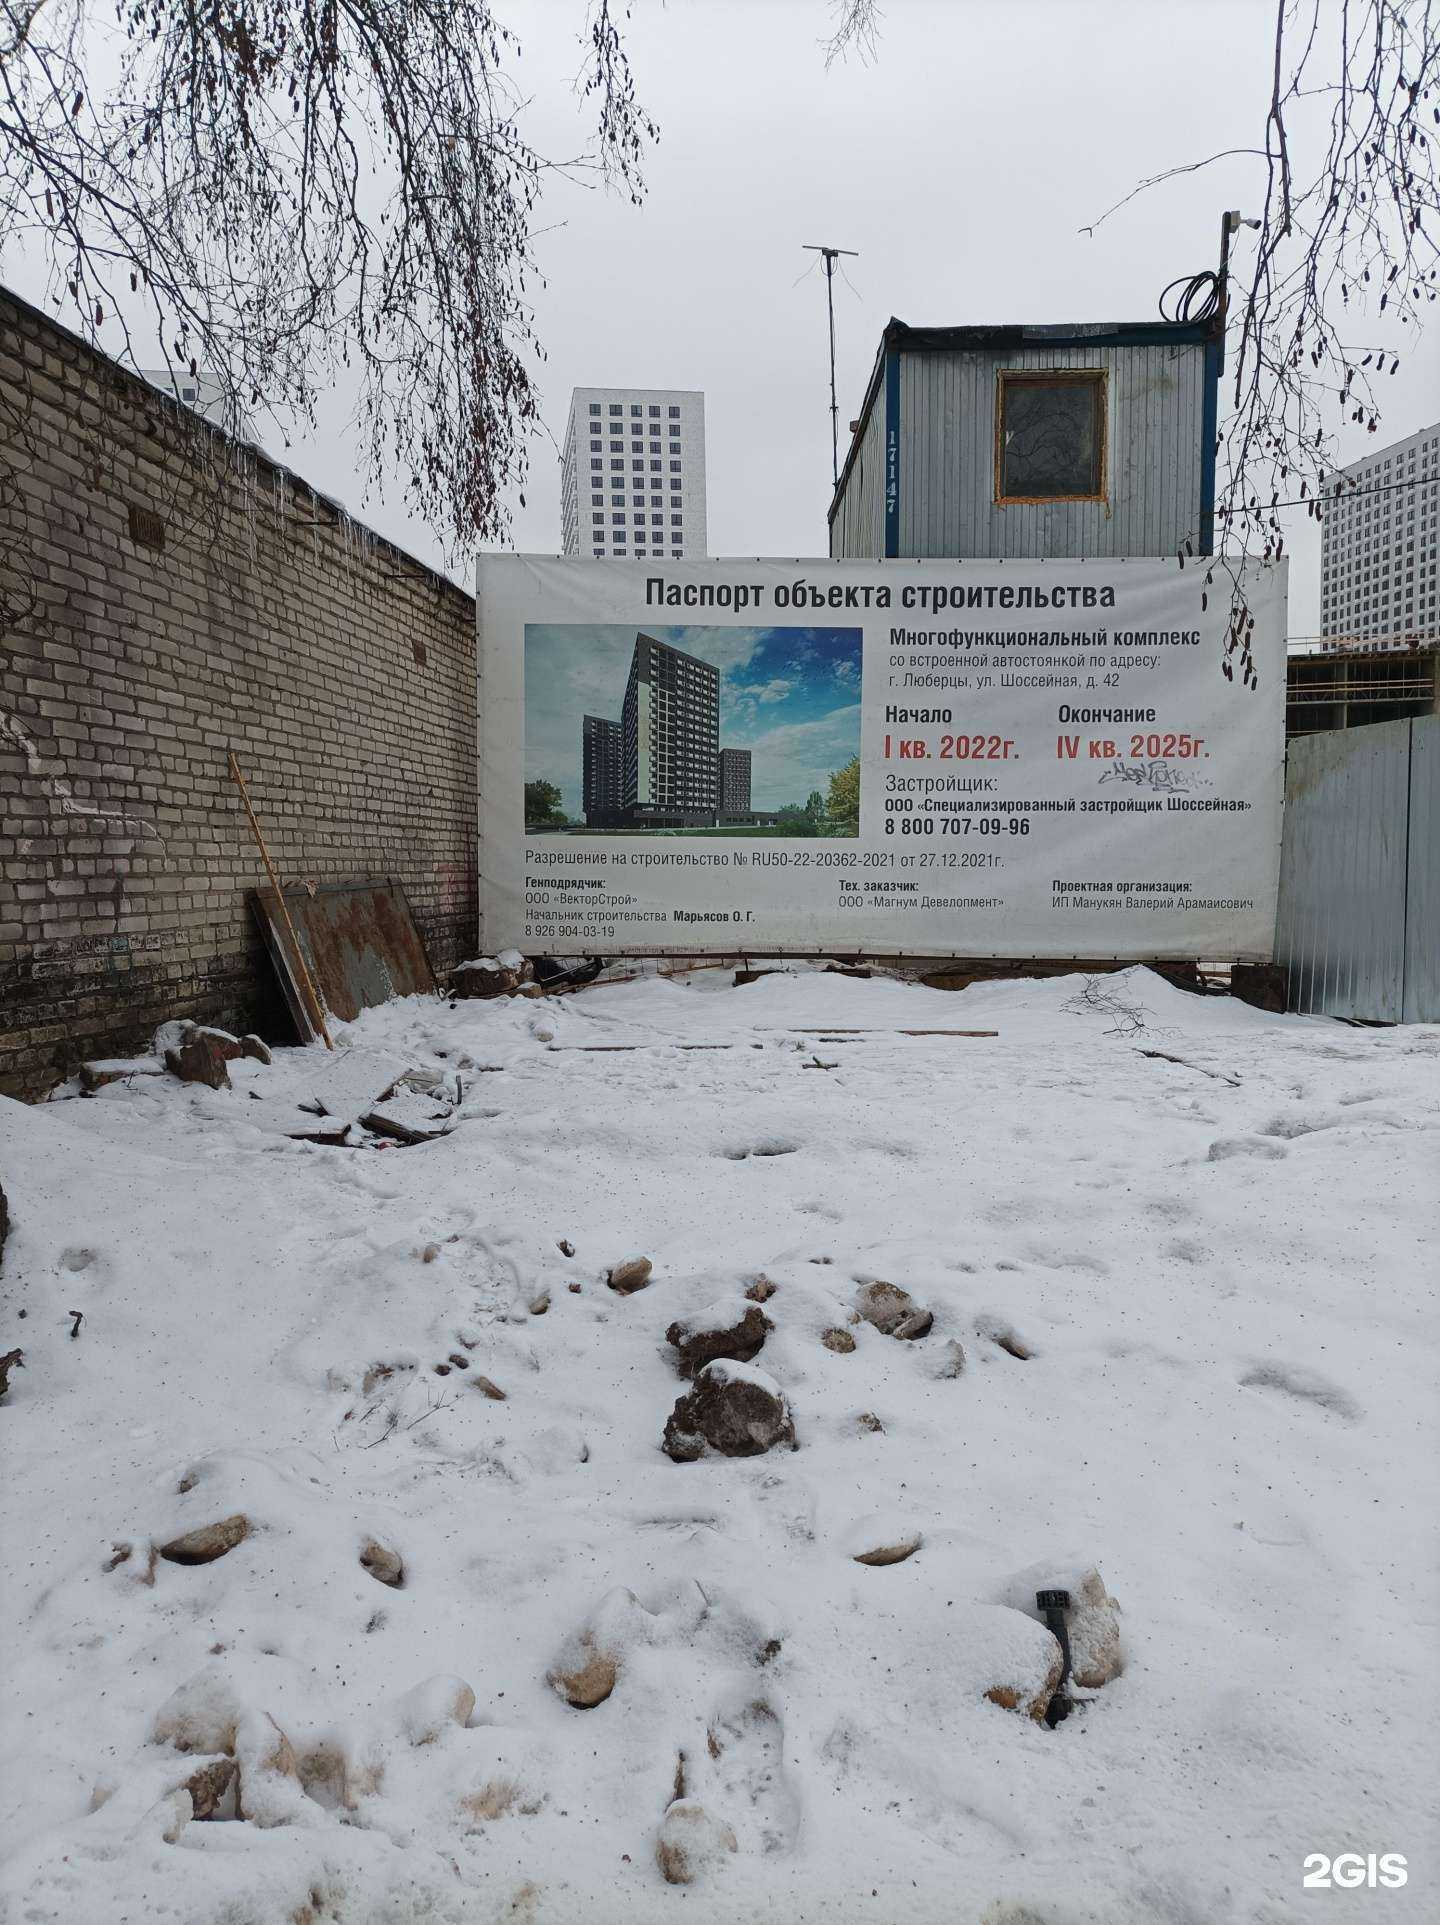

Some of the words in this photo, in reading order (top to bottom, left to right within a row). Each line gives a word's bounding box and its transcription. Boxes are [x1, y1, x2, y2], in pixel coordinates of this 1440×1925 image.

[887, 431, 898, 513] 17147
[647, 578, 764, 613] Паспорт
[775, 579, 891, 608] объекта
[902, 586, 1115, 614] строительства
[890, 628, 1107, 649] Многофункциональный
[1114, 631, 1200, 646] комплекс
[888, 656, 905, 668] со
[910, 653, 989, 669] встроенной
[992, 653, 1085, 669] автостоянкой
[1088, 657, 1106, 670] по
[1110, 656, 1160, 671] адресу:
[888, 674, 899, 688] г.
[903, 672, 973, 690] Люберцы,
[976, 676, 997, 690] ул.
[1001, 672, 1081, 688] Шоссейная,
[1086, 673, 1098, 689] д.
[1103, 673, 1119, 687] 42
[886, 706, 952, 725] Начало
[1059, 705, 1155, 723] Окончание
[885, 735, 890, 758] I
[900, 741, 931, 758] кв.
[940, 735, 1019, 759] 2022г.
[1058, 736, 1080, 758] IV
[1089, 741, 1121, 760] кв.
[1130, 734, 1209, 759] 2025г.
[884, 774, 997, 795] Застройщик:
[885, 799, 913, 811] ООО
[918, 798, 1075, 814] «Специализированный
[1080, 798, 1162, 814] застройщик
[1168, 797, 1251, 811] Шоссейная»
[885, 818, 894, 834] 8
[902, 818, 933, 835] 800
[940, 818, 1029, 835] 707-09-96
[526, 849, 607, 867] Разрешение
[612, 854, 627, 864] на
[631, 854, 728, 868] строительство
[733, 852, 747, 866] №
[752, 851, 894, 867] RU50-22-20362-2021
[899, 856, 915, 869] от
[920, 853, 1006, 869] 27.12.2021г.
[526, 877, 605, 891] Генподрядчик:
[839, 880, 860, 891] Тех.
[864, 880, 918, 891] заказчик:
[1053, 880, 1113, 894] Проектная
[1117, 883, 1192, 894] организация:
[523, 892, 551, 904] ООО
[552, 891, 637, 907] «ВекторСтрой»
[839, 895, 864, 908] ООО
[868, 894, 917, 910] «Магнум
[921, 896, 1004, 911] Девелопмент»
[1053, 896, 1069, 907] ИП
[1071, 896, 1124, 911] Манукян
[1126, 894, 1175, 911] Валерий
[1177, 896, 1255, 911] Арамаисович
[523, 909, 583, 922] Начальник
[586, 912, 667, 924] строительства
[674, 911, 729, 924] Марьясов
[733, 911, 743, 922] О.
[747, 911, 755, 922] Г.
[523, 925, 532, 936] 8
[535, 924, 557, 936] 926
[557, 923, 616, 937] 904-03-19
